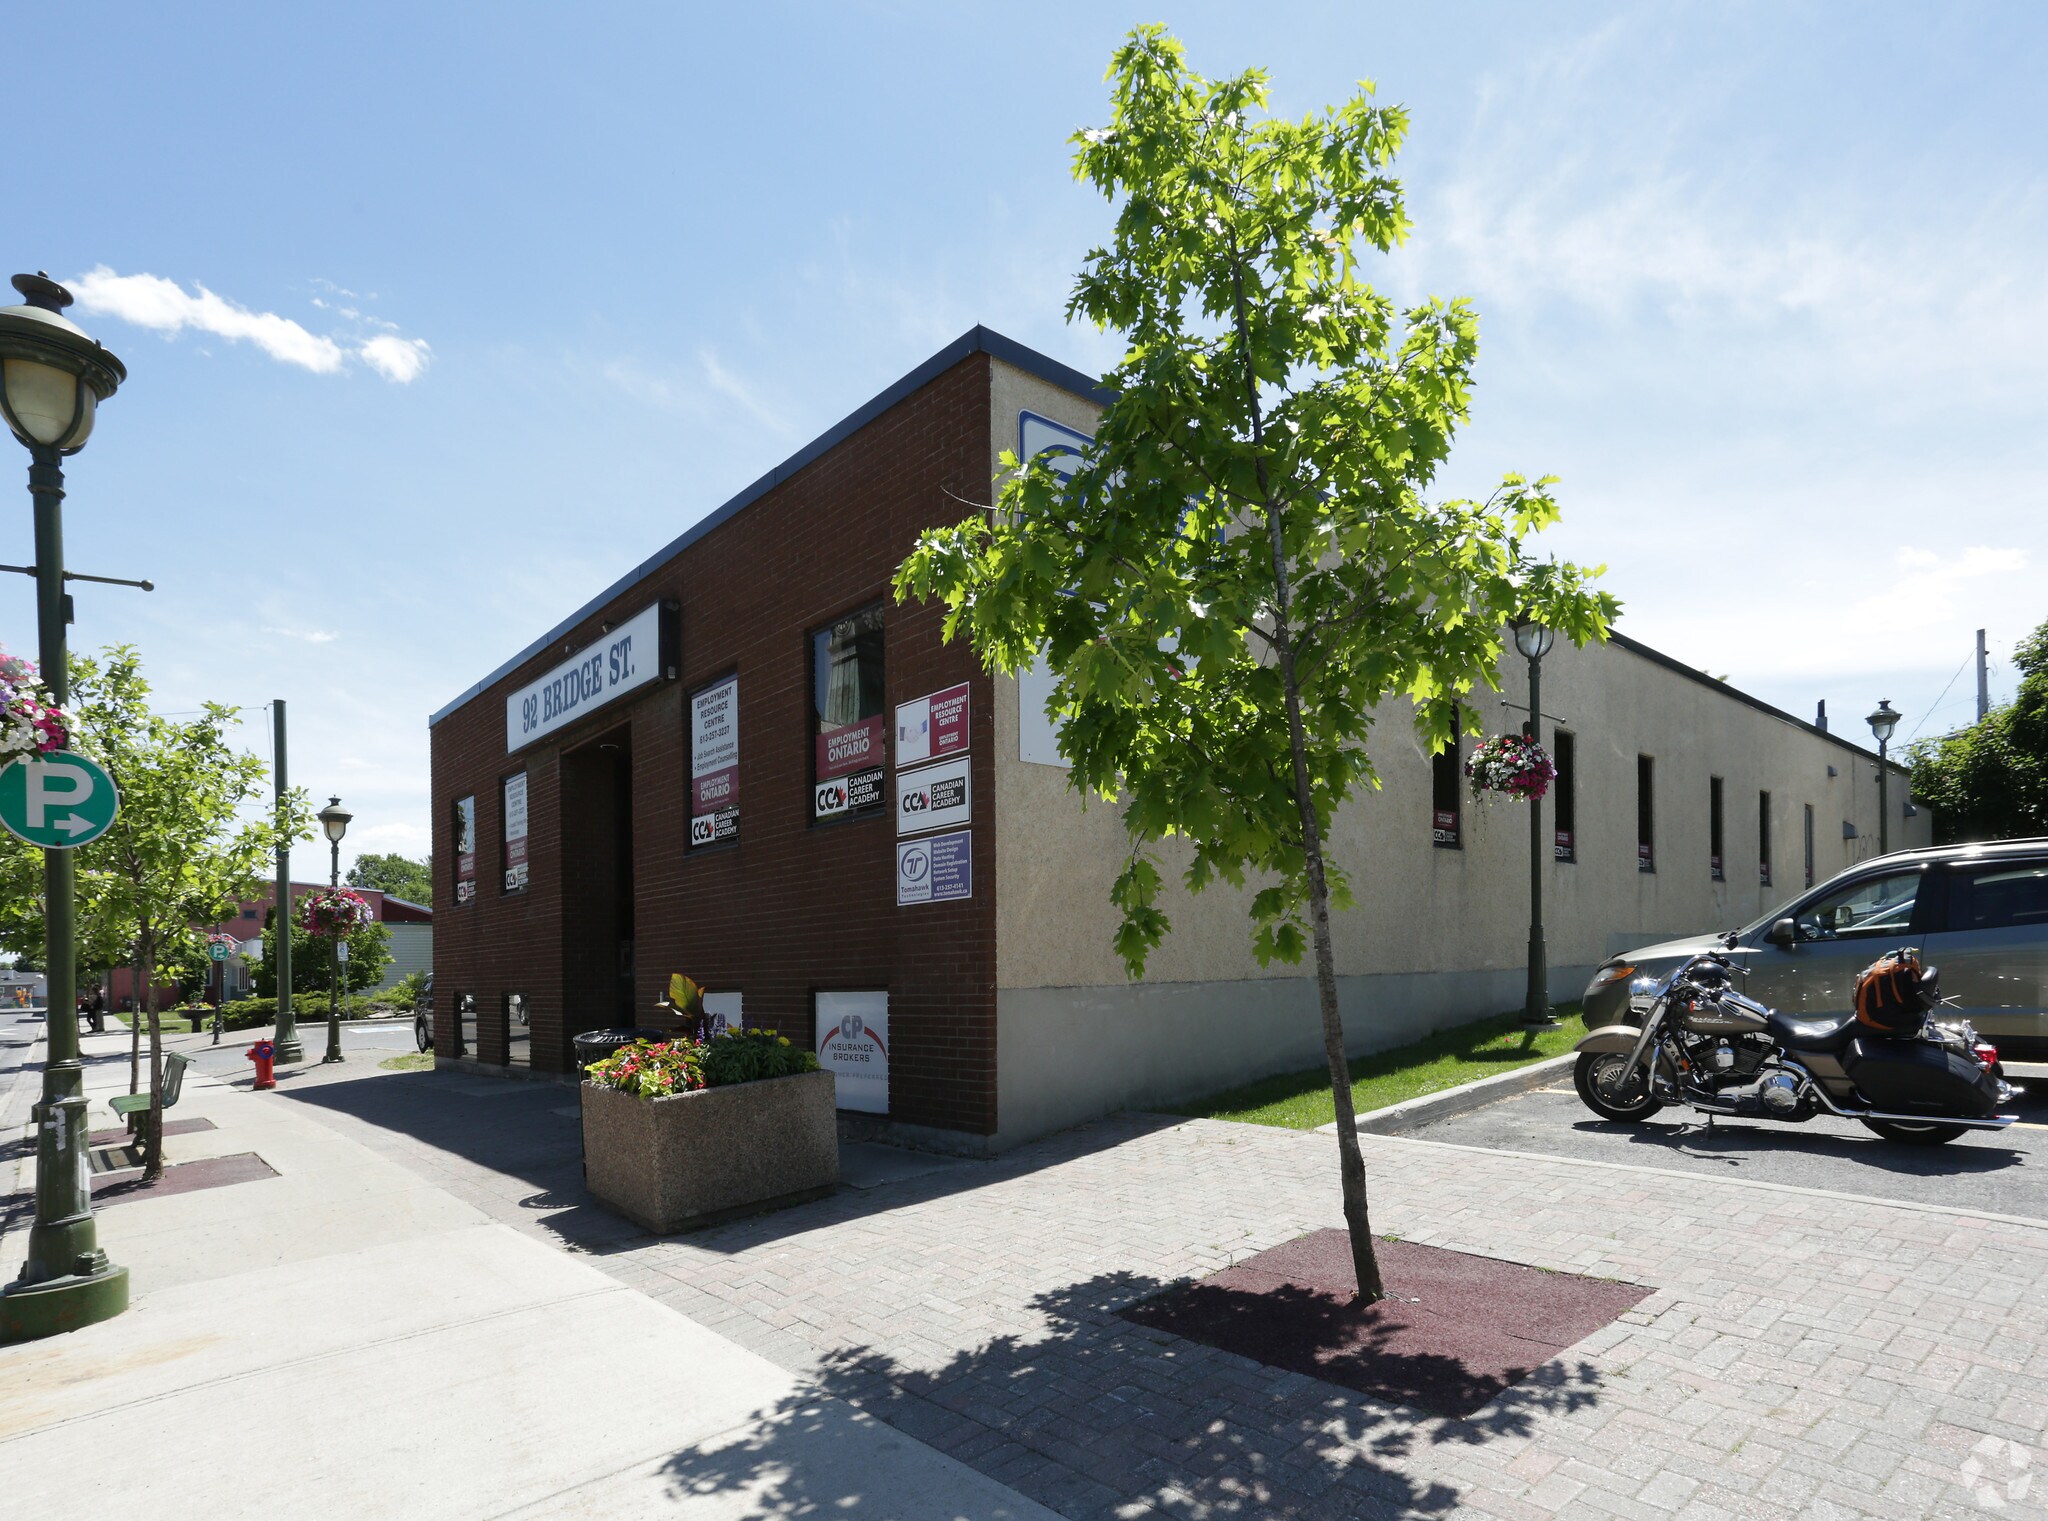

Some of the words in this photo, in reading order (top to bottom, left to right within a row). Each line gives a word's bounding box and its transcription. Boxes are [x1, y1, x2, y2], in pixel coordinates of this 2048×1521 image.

[522, 693, 538, 734] 92
[543, 653, 602, 723] BRIDGE
[609, 635, 635, 687] ST.
[697, 686, 732, 709] EMPLOYMENT
[930, 694, 967, 713] EMPLOYMENT
[700, 700, 728, 719] RESOURCE
[935, 704, 962, 719] RESOURCE
[704, 714, 725, 729] CENTRE
[939, 714, 958, 726] CENTRE
[828, 727, 870, 749] EMPLOYMENT
[938, 735, 959, 746] ONTARIO
[828, 737, 870, 762] ONTARIO
[700, 773, 730, 790] EMPLOYMENT
[849, 770, 883, 787] CANADIAN
[932, 779, 964, 793] CANADIAN
[26, 760, 95, 828] P
[700, 783, 730, 802] ONTARIO
[849, 783, 873, 796] CAREER
[932, 789, 954, 800] CAREER
[817, 785, 843, 811] CCA
[849, 791, 880, 806] ACADEMY
[902, 791, 927, 813] CCA
[932, 796, 961, 809] ACADEMY
[715, 808, 740, 821] CANADIAN
[693, 820, 712, 841] CCA
[715, 818, 733, 829] CAREER
[716, 825, 737, 837] ACADEMY
[901, 884, 929, 893] Tomahawk
[214, 945, 225, 958] P
[841, 1015, 863, 1039] CP
[828, 1043, 874, 1052] INSURANCE
[833, 1053, 870, 1062] BROKERS
